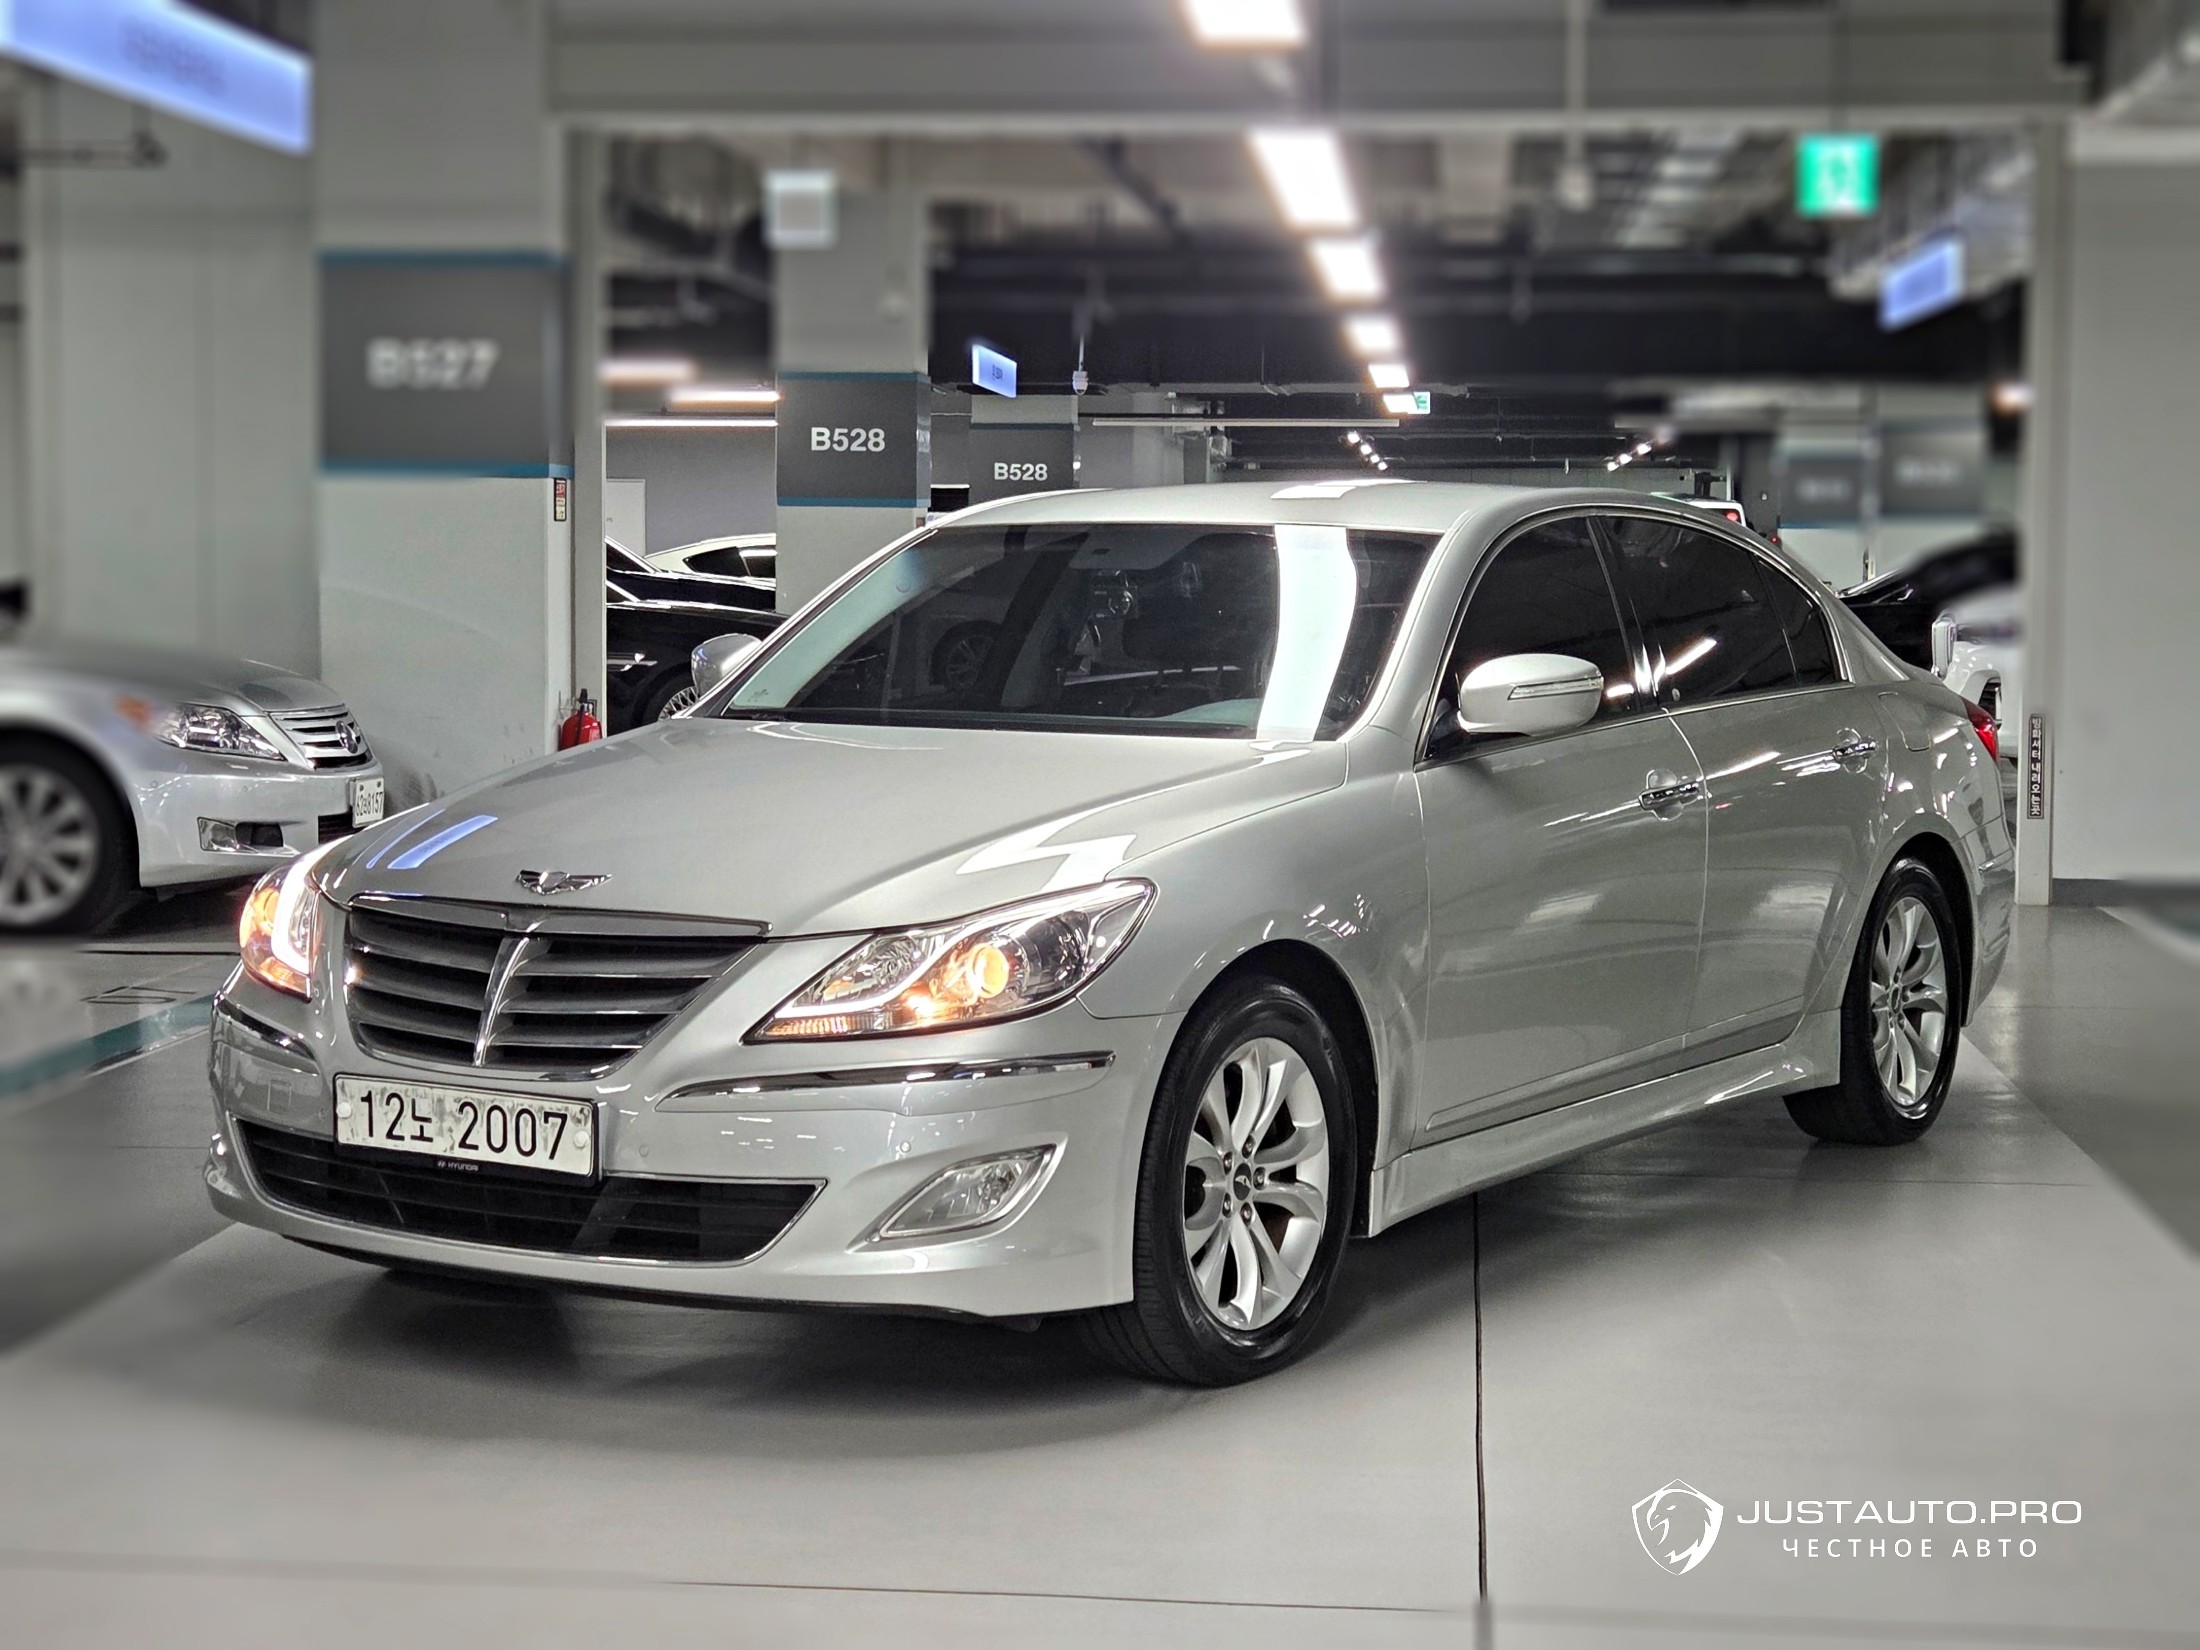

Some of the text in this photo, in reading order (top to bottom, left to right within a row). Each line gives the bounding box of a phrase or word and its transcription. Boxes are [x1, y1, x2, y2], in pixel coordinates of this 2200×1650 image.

[366, 337, 500, 390] B527
[811, 427, 886, 452] B528
[993, 462, 1048, 481] B528
[361, 1090, 568, 1160] 12노 2007
